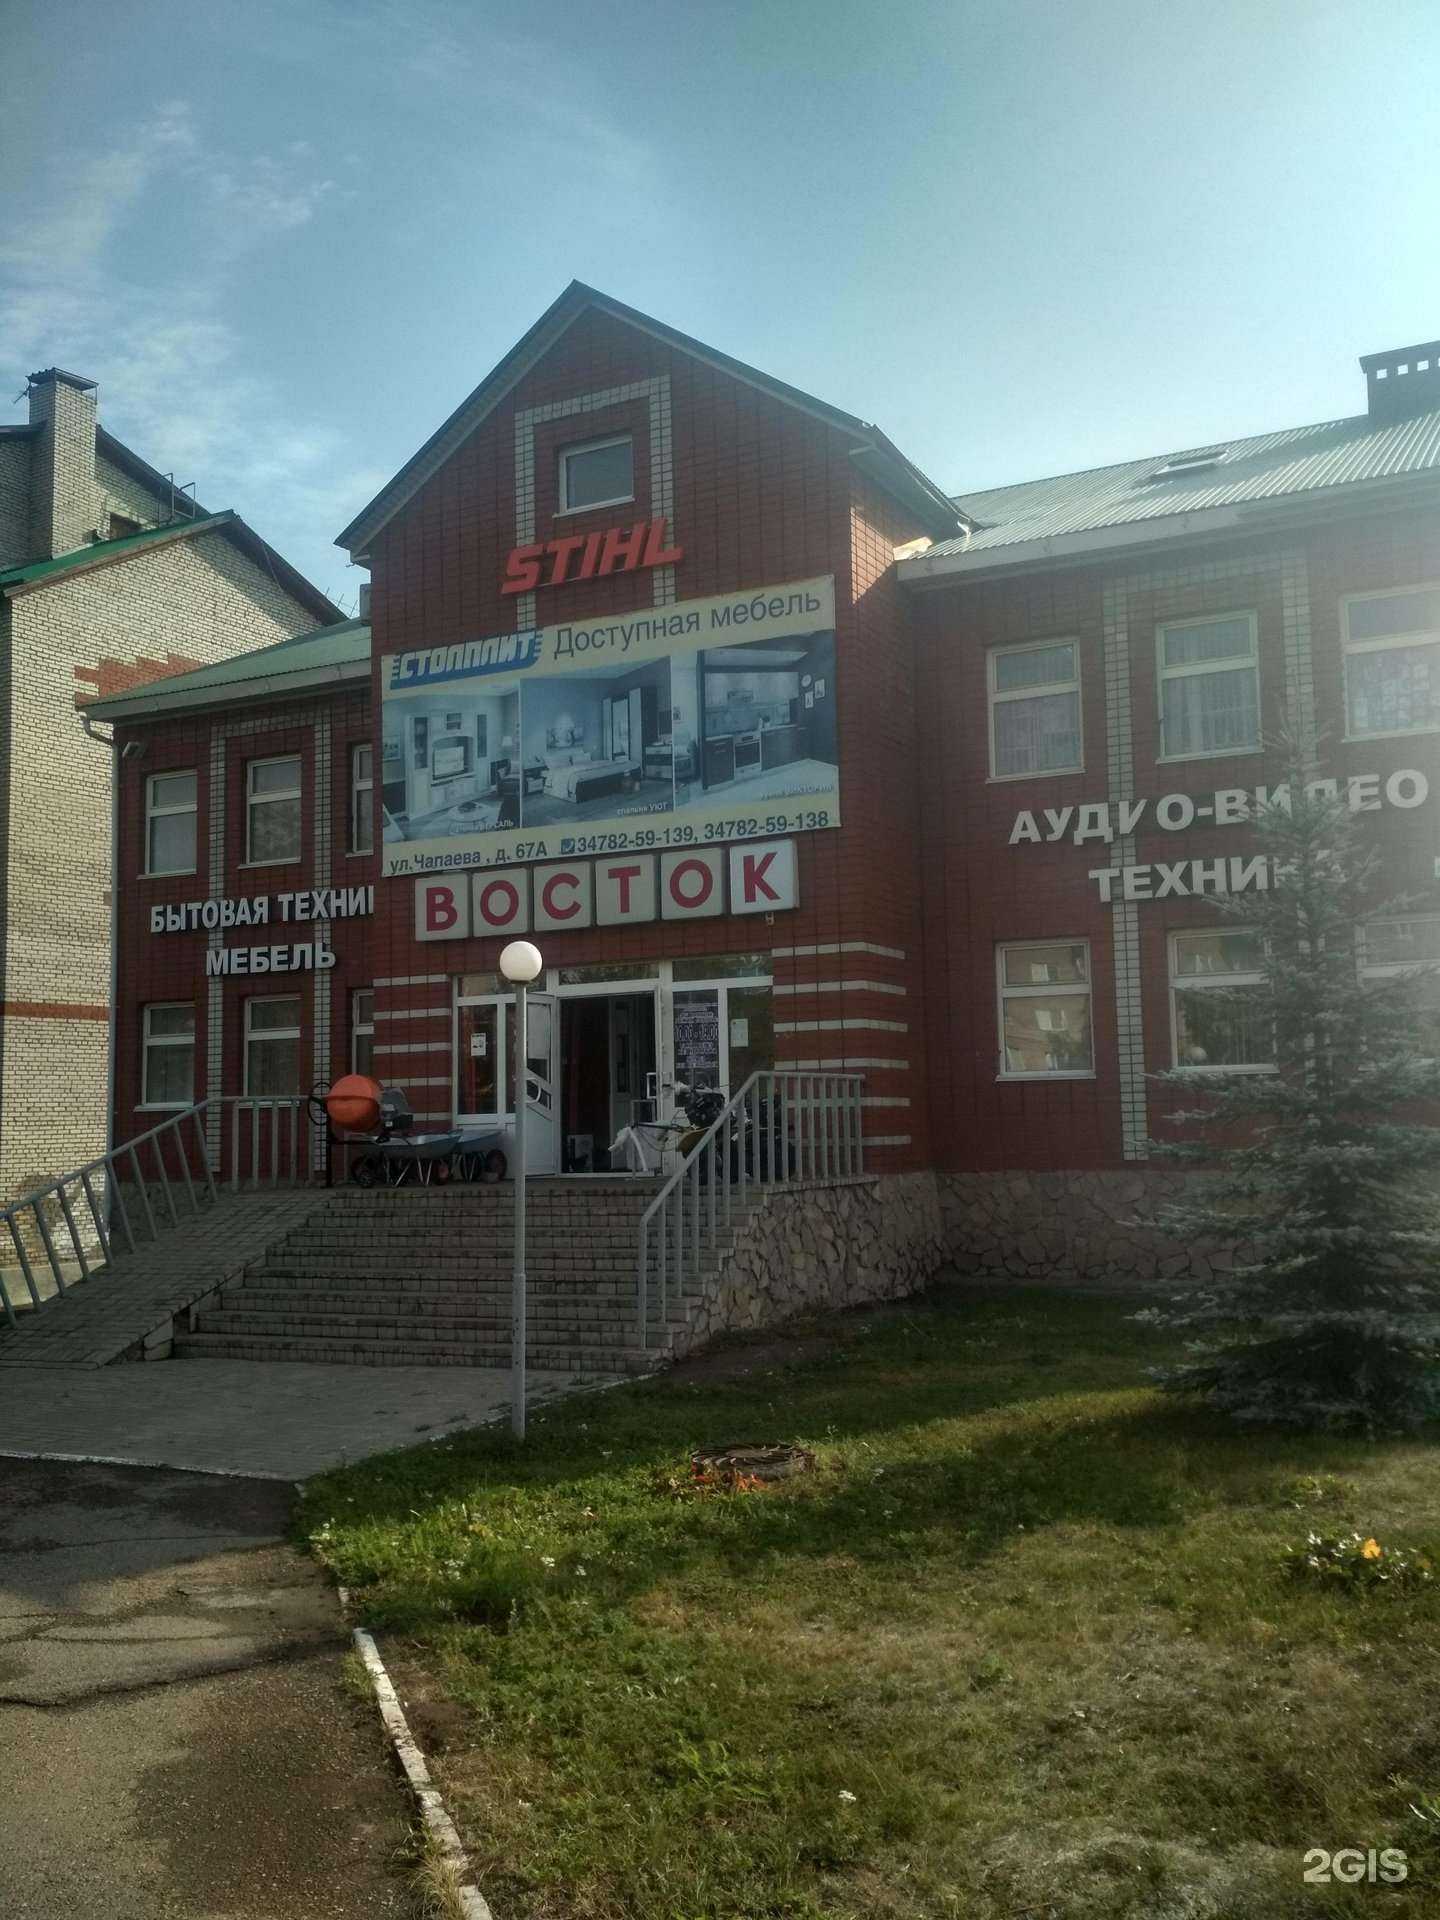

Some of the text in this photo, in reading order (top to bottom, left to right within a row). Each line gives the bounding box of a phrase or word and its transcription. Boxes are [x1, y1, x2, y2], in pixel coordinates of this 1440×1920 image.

[501, 516, 684, 595] STIHL
[553, 591, 821, 660] Доступная мебель
[516, 840, 547, 859] 67А
[577, 810, 829, 853] 34782-59-139, 34782-59-138
[426, 851, 781, 932] ВОСТОК
[150, 895, 269, 934] БЫТОВАЯ
[205, 942, 337, 977] МЕБЕЛЬ
